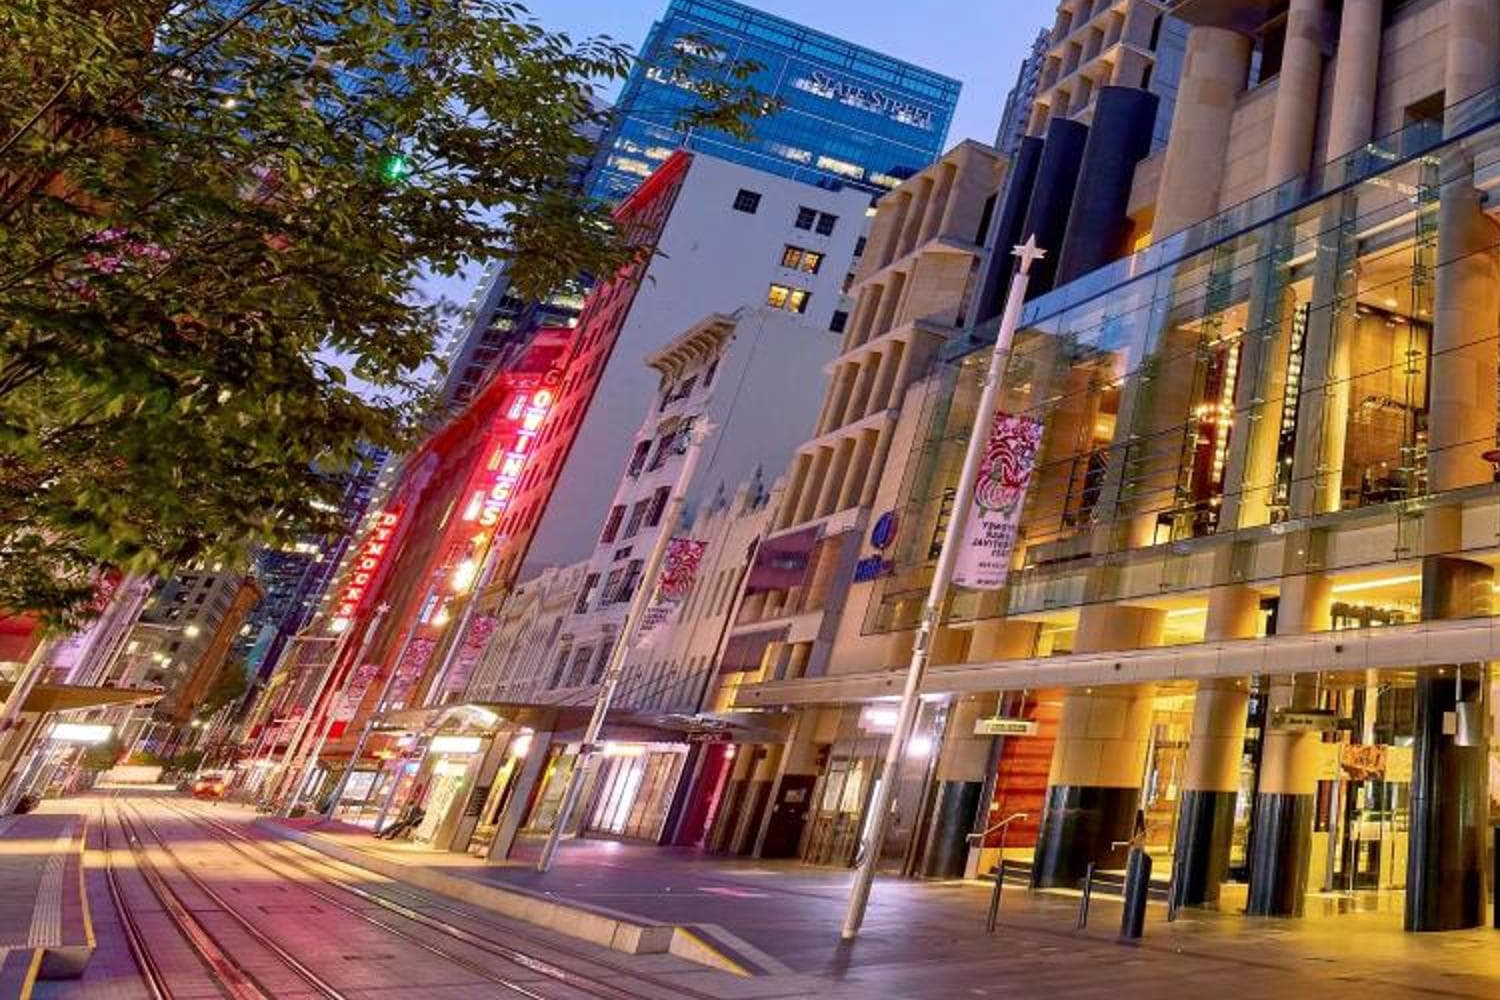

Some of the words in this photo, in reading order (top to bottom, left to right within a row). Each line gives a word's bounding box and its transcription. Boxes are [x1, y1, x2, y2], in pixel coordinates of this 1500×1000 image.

[812, 70, 867, 100] STATE
[871, 90, 934, 128] STREET
[480, 368, 563, 528] GOWINGS
